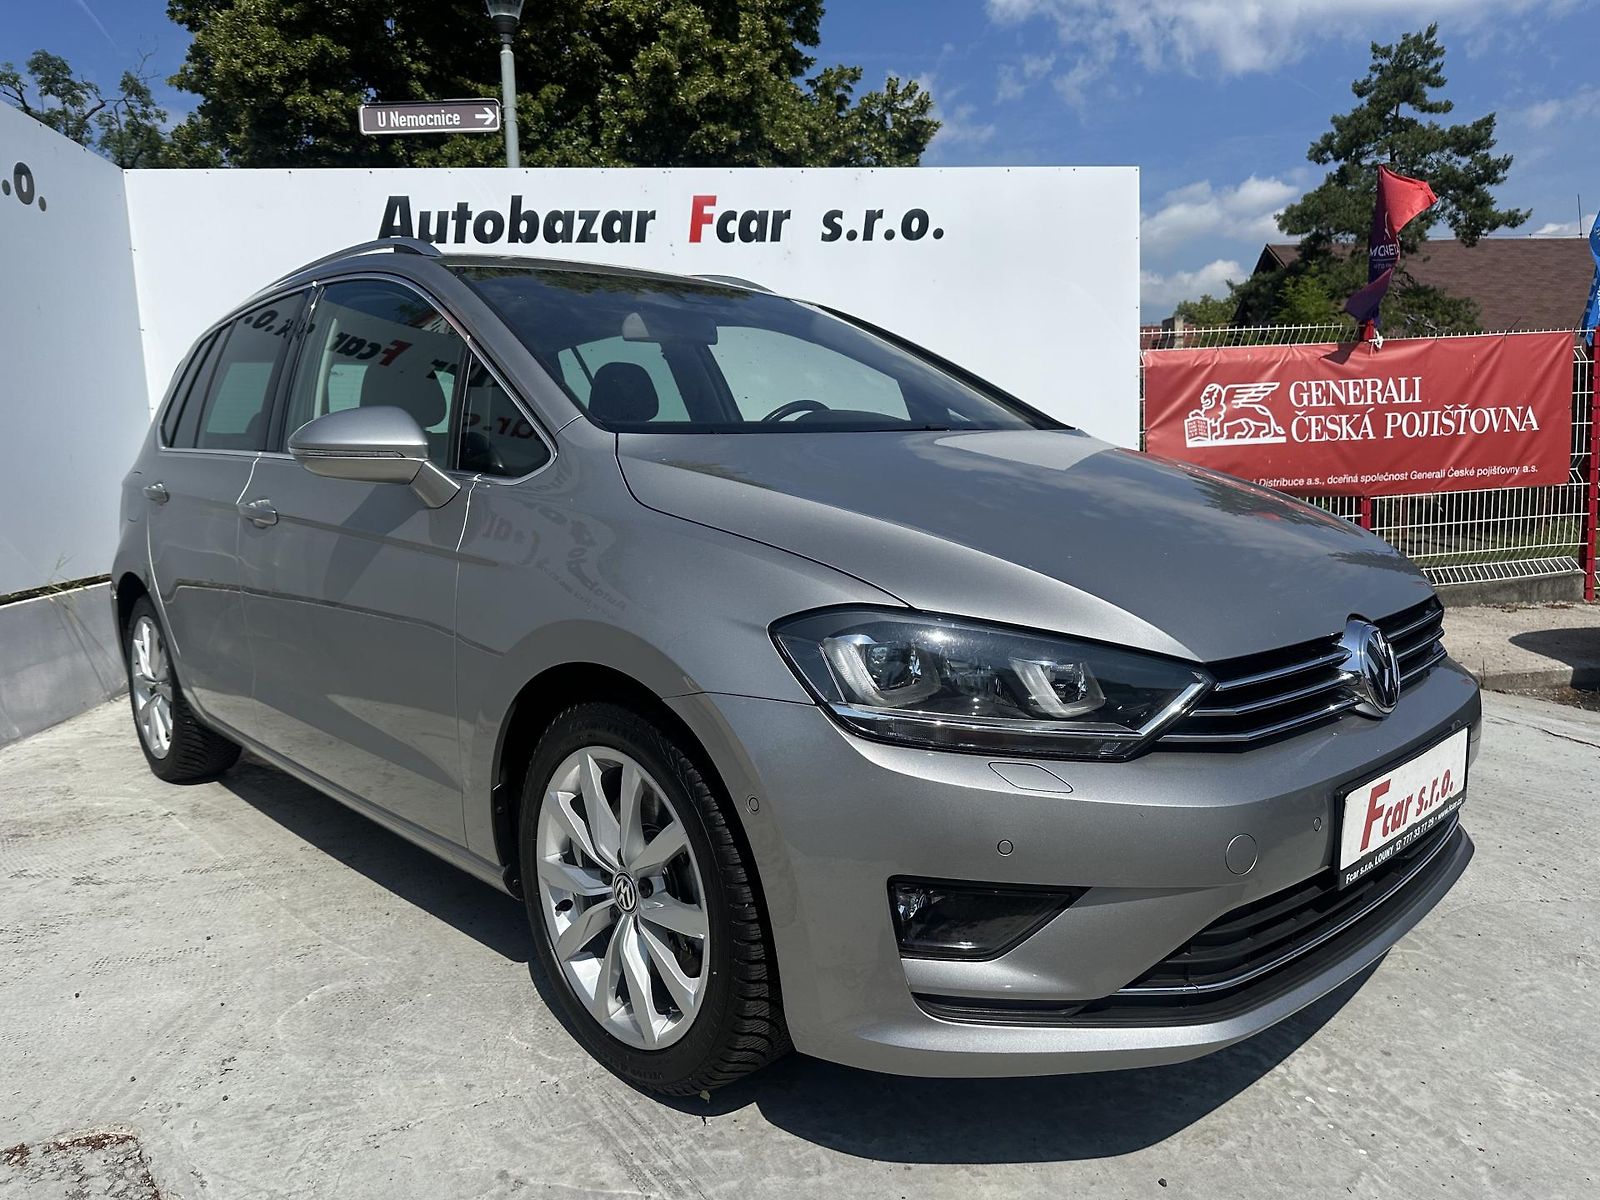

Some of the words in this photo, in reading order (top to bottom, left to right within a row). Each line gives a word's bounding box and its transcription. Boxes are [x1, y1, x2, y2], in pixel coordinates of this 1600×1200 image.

[377, 111, 388, 127] U
[390, 110, 461, 128] Nemocnice
[378, 195, 656, 244] Autobazar
[688, 195, 792, 244] Fcar
[820, 208, 945, 243] s.r.o.
[1289, 377, 1422, 408] GENERALI
[1290, 407, 1377, 442] ČESKÁ
[1383, 403, 1540, 439] POJIŠŤOVNA
[1258, 477, 1305, 488] Distribuce
[1327, 473, 1359, 485] dceřiná
[1360, 471, 1408, 484] společnost
[1410, 469, 1446, 481] Generali
[1447, 466, 1475, 478] České
[1522, 463, 1538, 473] a.s.
[1359, 778, 1413, 853] Fcar
[1416, 768, 1455, 817] s.r.o.
[1345, 869, 1360, 885] Fcar
